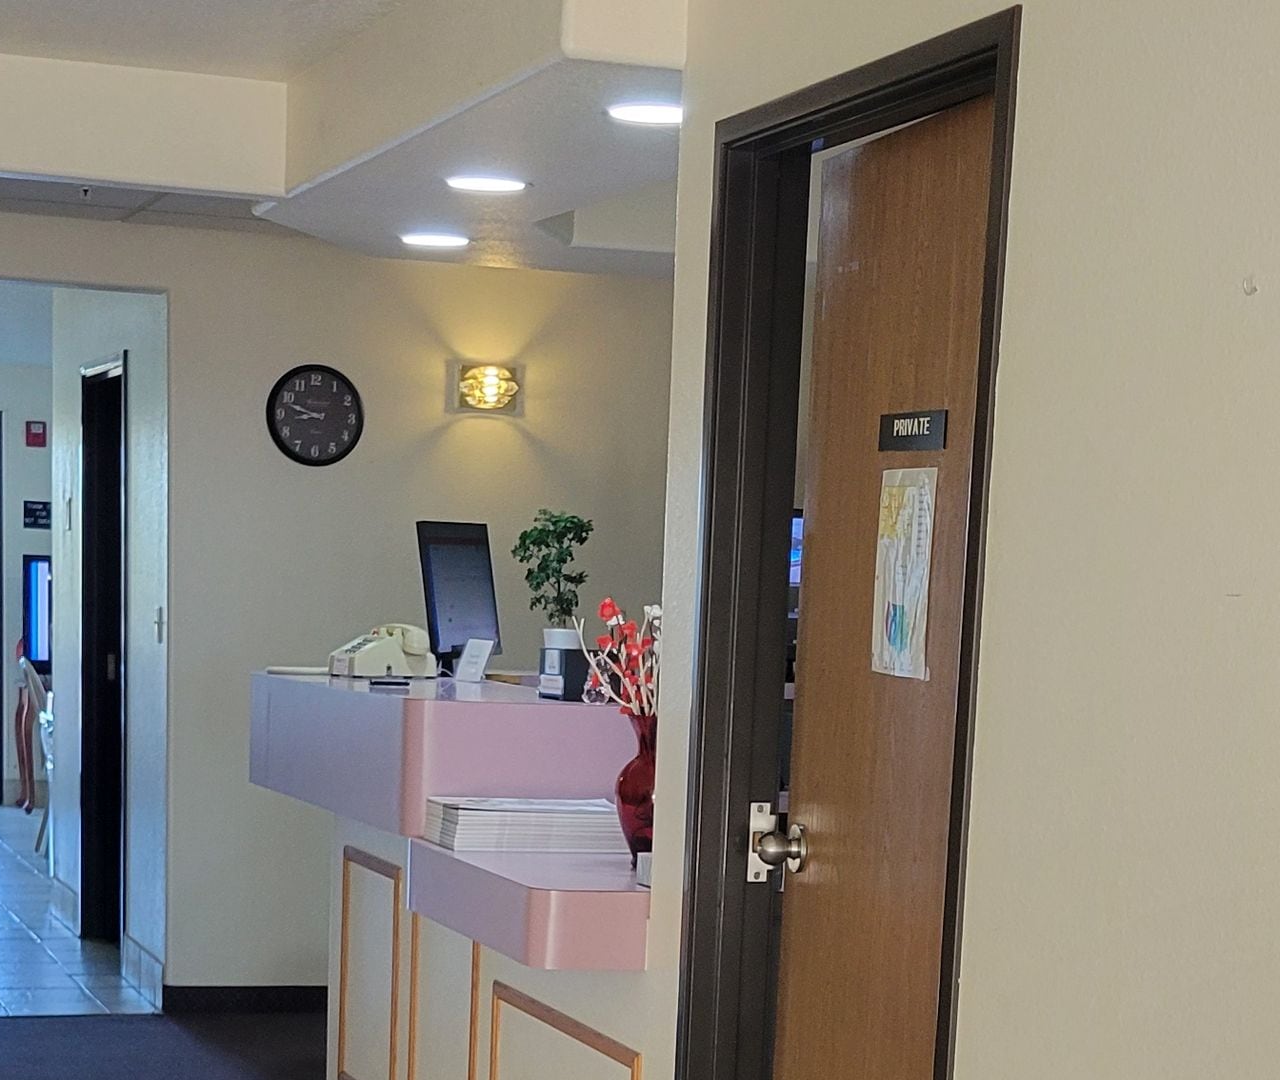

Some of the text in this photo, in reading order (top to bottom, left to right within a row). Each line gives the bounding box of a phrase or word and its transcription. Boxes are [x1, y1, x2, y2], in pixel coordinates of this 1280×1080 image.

[295, 380, 305, 391] 11
[310, 374, 321, 386] 12
[332, 381, 337, 392] 1
[282, 391, 294, 403] 10
[343, 394, 352, 406] 2
[276, 408, 285, 420] 9
[347, 413, 356, 425] 3
[282, 426, 290, 438] 8
[893, 416, 931, 436] PRIVATE
[341, 430, 349, 441] 4
[294, 440, 301, 452] 7
[310, 445, 319, 457] 6
[328, 442, 336, 453] 5
